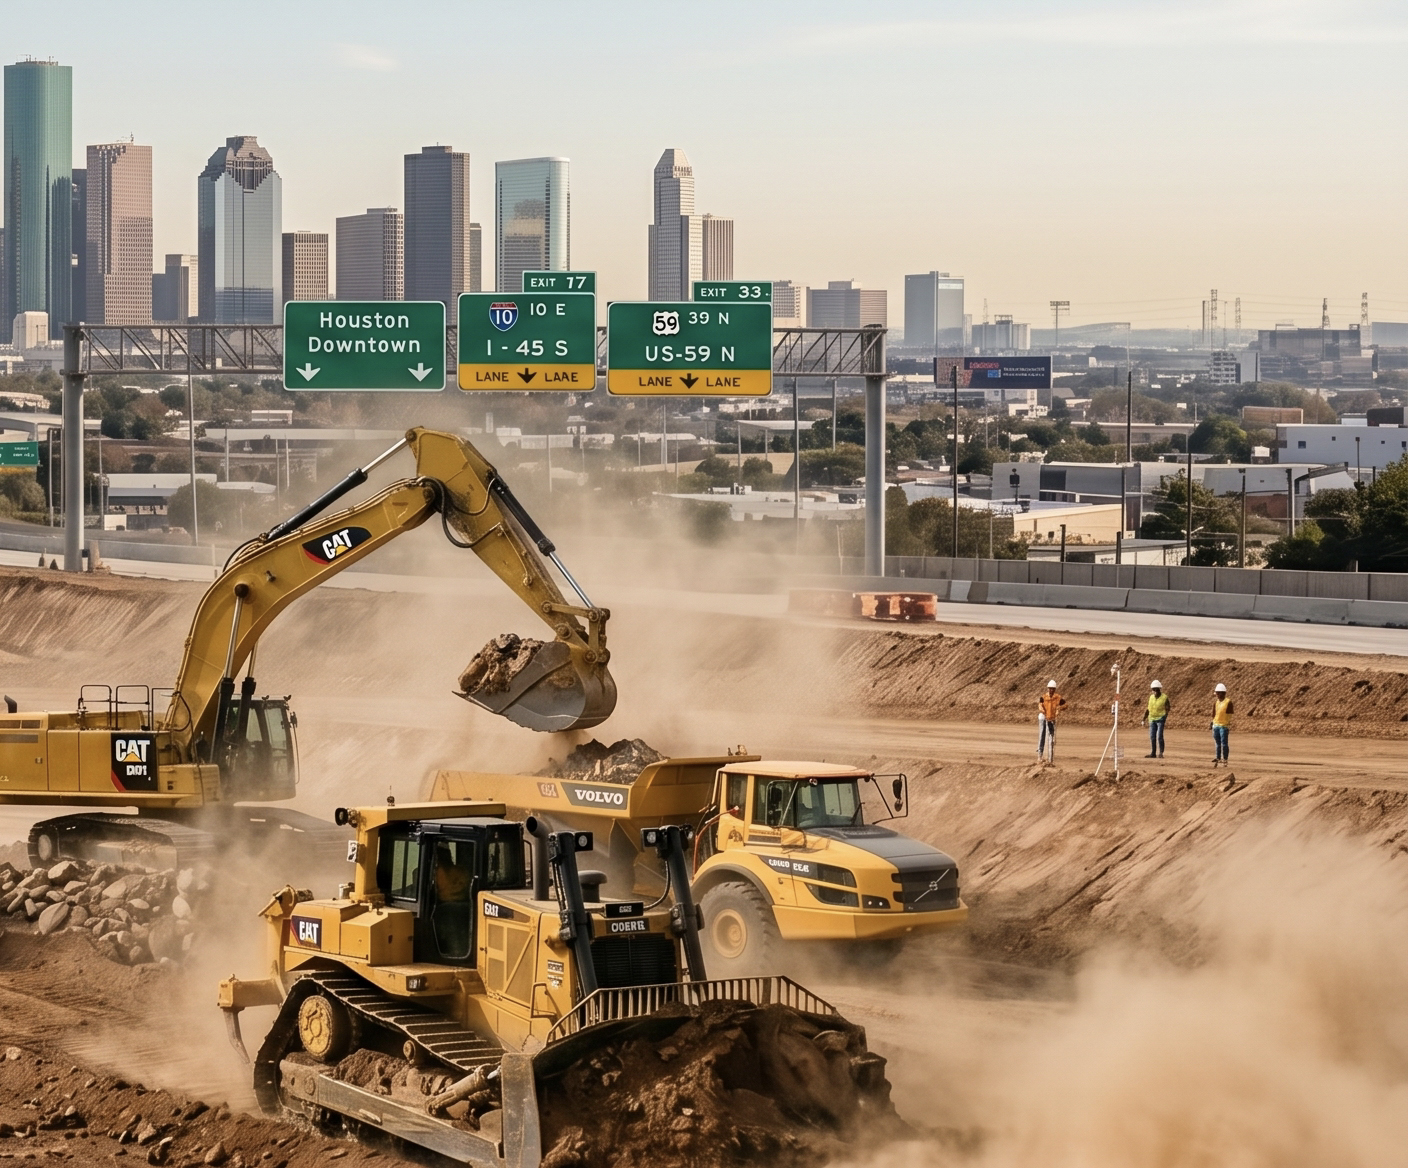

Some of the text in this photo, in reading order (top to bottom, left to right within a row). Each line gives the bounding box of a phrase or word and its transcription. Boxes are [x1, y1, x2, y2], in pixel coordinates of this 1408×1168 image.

[531, 276, 587, 289] EXIT 17
[700, 286, 761, 298] EXIT 33
[496, 310, 513, 325] 10
[530, 303, 547, 316] 10
[556, 303, 566, 316] E
[320, 312, 409, 328] Houston
[655, 315, 677, 331] 59
[688, 311, 729, 325] 39 N
[308, 336, 421, 353] Downtown
[515, 340, 544, 356] 45
[555, 340, 568, 356] S
[645, 346, 734, 362] US-59 N
[476, 371, 509, 382] LANE
[638, 376, 741, 387] LANE LANE
[322, 529, 352, 559] CAT
[115, 739, 151, 762] CAT
[574, 789, 624, 805] VOLVO
